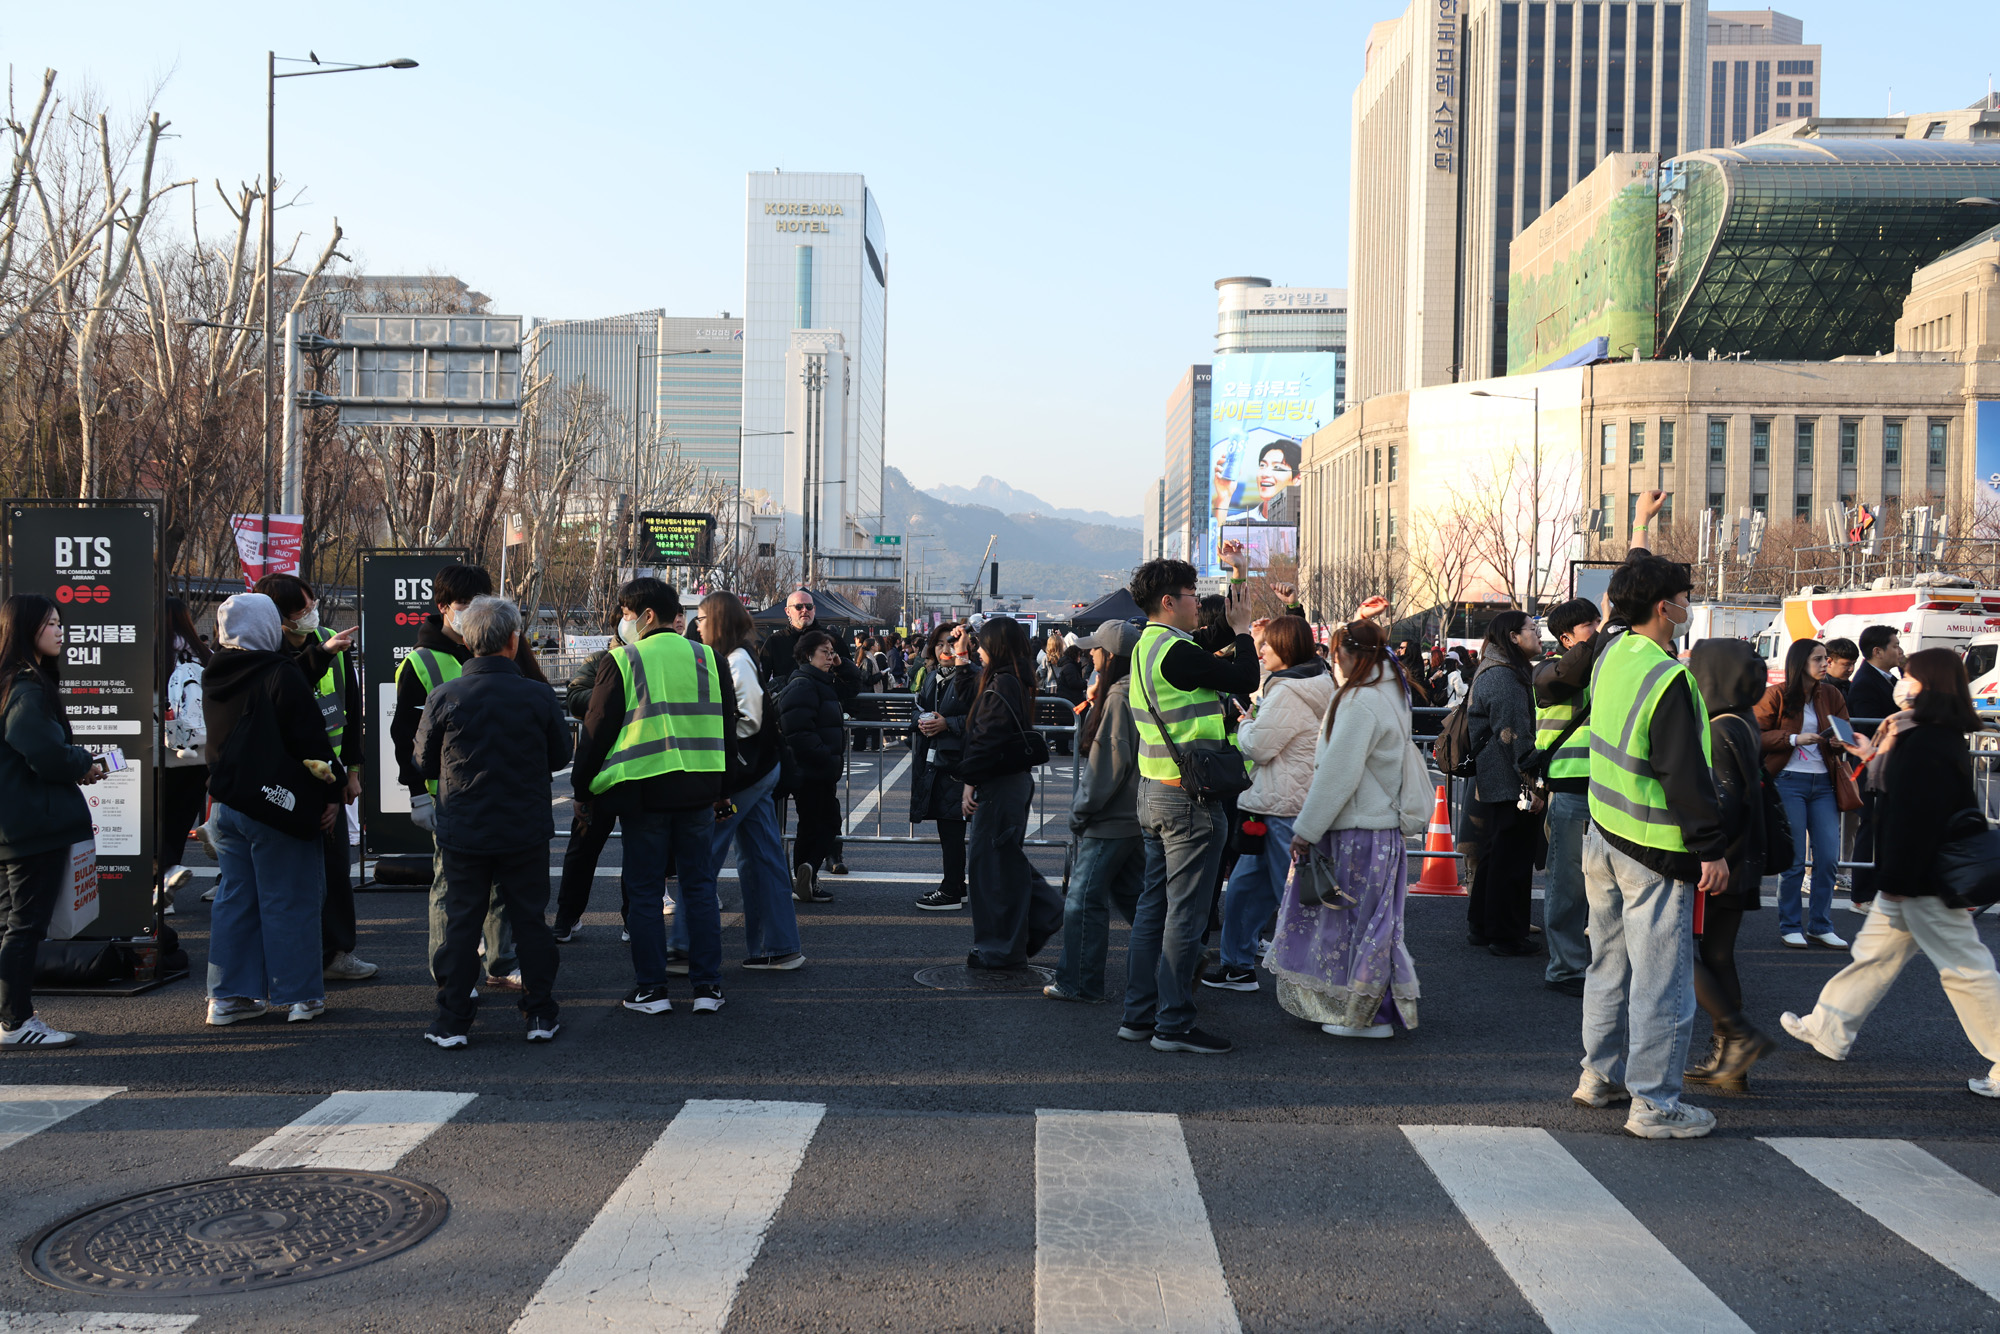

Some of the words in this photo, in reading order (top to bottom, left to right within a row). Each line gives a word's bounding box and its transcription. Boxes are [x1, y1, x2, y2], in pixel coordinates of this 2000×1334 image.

[1434, 0, 1457, 174] 한국프레스센터
[765, 203, 843, 216] KOREANA
[776, 220, 829, 233] HOTEL
[1263, 292, 1330, 306] 동아일보
[1222, 381, 1252, 398] 오늘
[1254, 380, 1301, 398] 하루도
[1213, 400, 1264, 421] 라이트
[1267, 400, 1316, 421] 엔딩!
[55, 537, 111, 567] BTS
[395, 578, 433, 600] BTS
[69, 625, 136, 643] 금지물품
[66, 647, 101, 665] 안내
[65, 705, 82, 714] 반입
[83, 705, 100, 714] 가능
[101, 705, 118, 714] 품목
[261, 785, 287, 801] NORTH
[276, 784, 289, 795] THE
[265, 793, 285, 807] FACE
